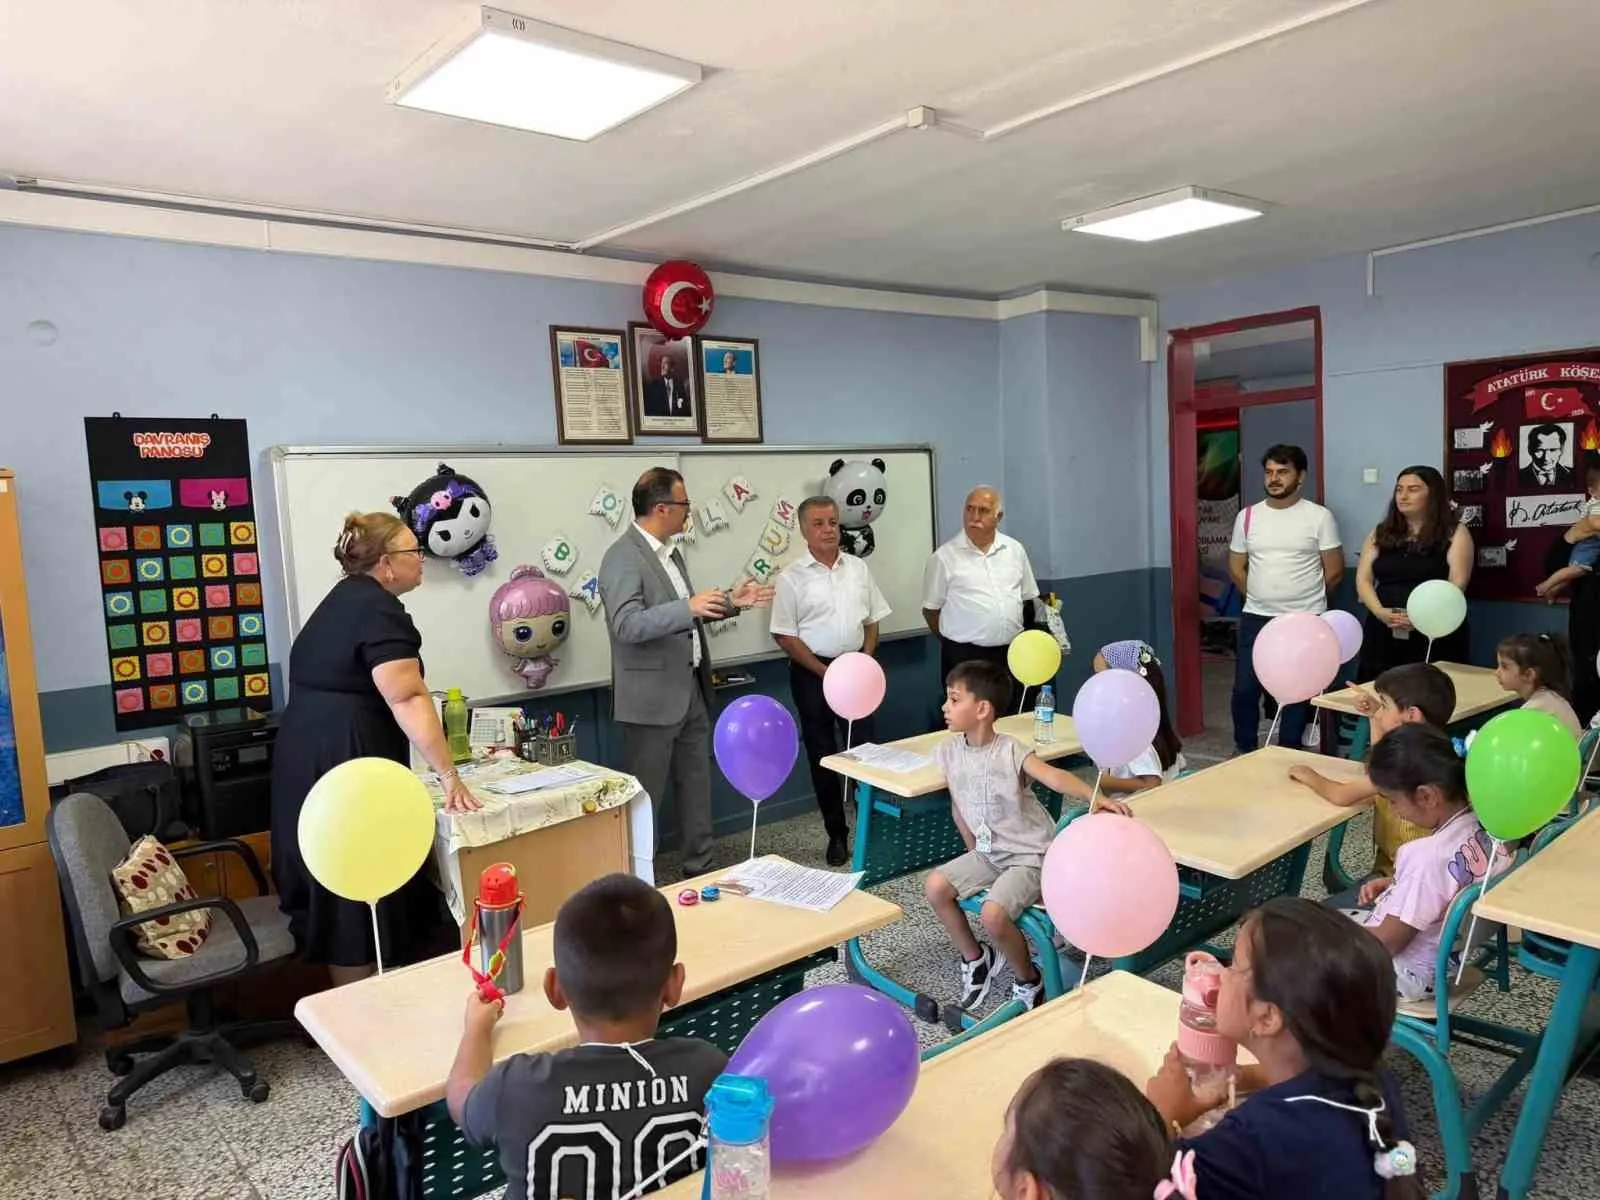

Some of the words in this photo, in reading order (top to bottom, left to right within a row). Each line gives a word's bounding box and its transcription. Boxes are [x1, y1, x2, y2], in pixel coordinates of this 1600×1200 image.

[1487, 368, 1549, 393] ATATÜRK
[140, 445, 204, 458] PANOSU
[562, 1075, 689, 1114] MINION
